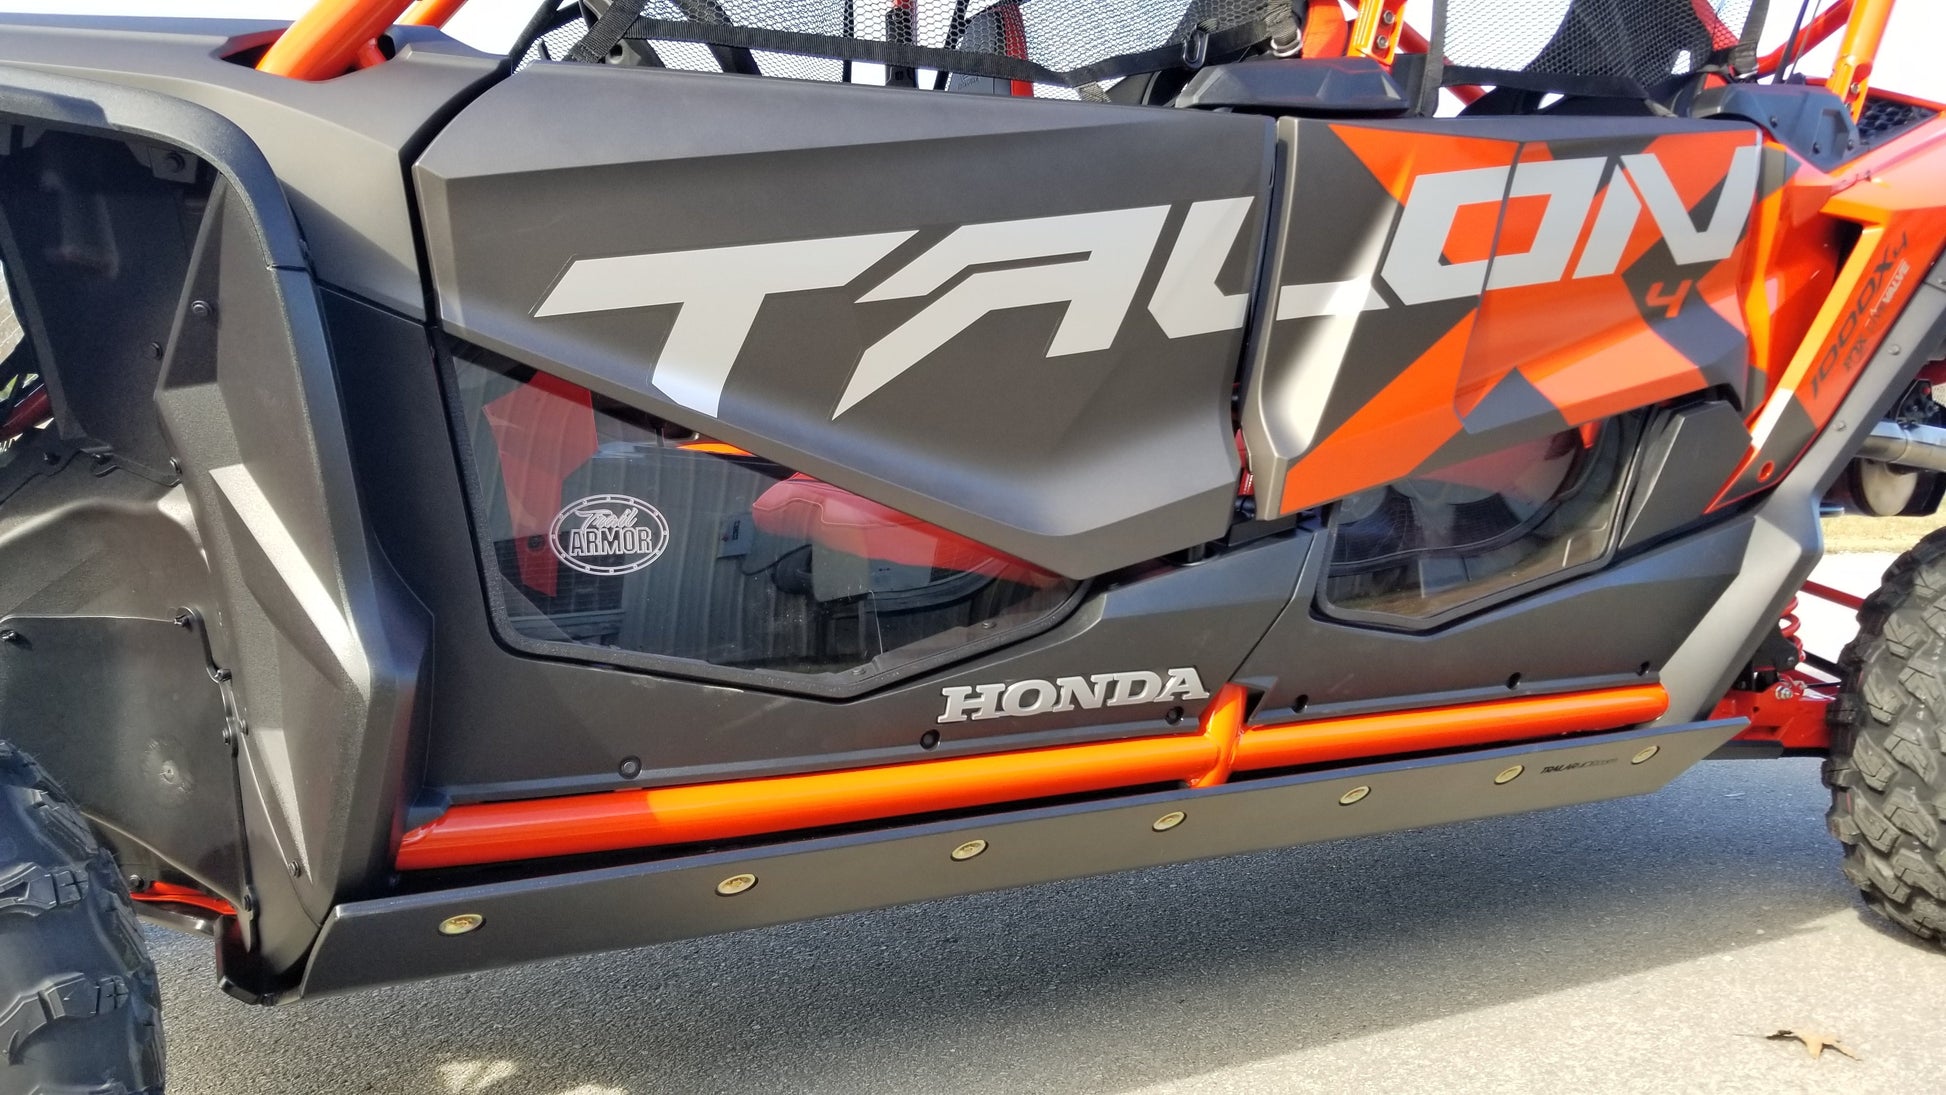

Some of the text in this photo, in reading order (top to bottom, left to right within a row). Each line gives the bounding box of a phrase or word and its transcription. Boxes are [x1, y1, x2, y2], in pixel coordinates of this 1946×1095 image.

[534, 145, 1758, 420] TALON
[1645, 279, 1692, 318] 4
[574, 507, 638, 531] Trail
[569, 527, 653, 556] ARMOR
[938, 667, 1210, 723] HONDA
